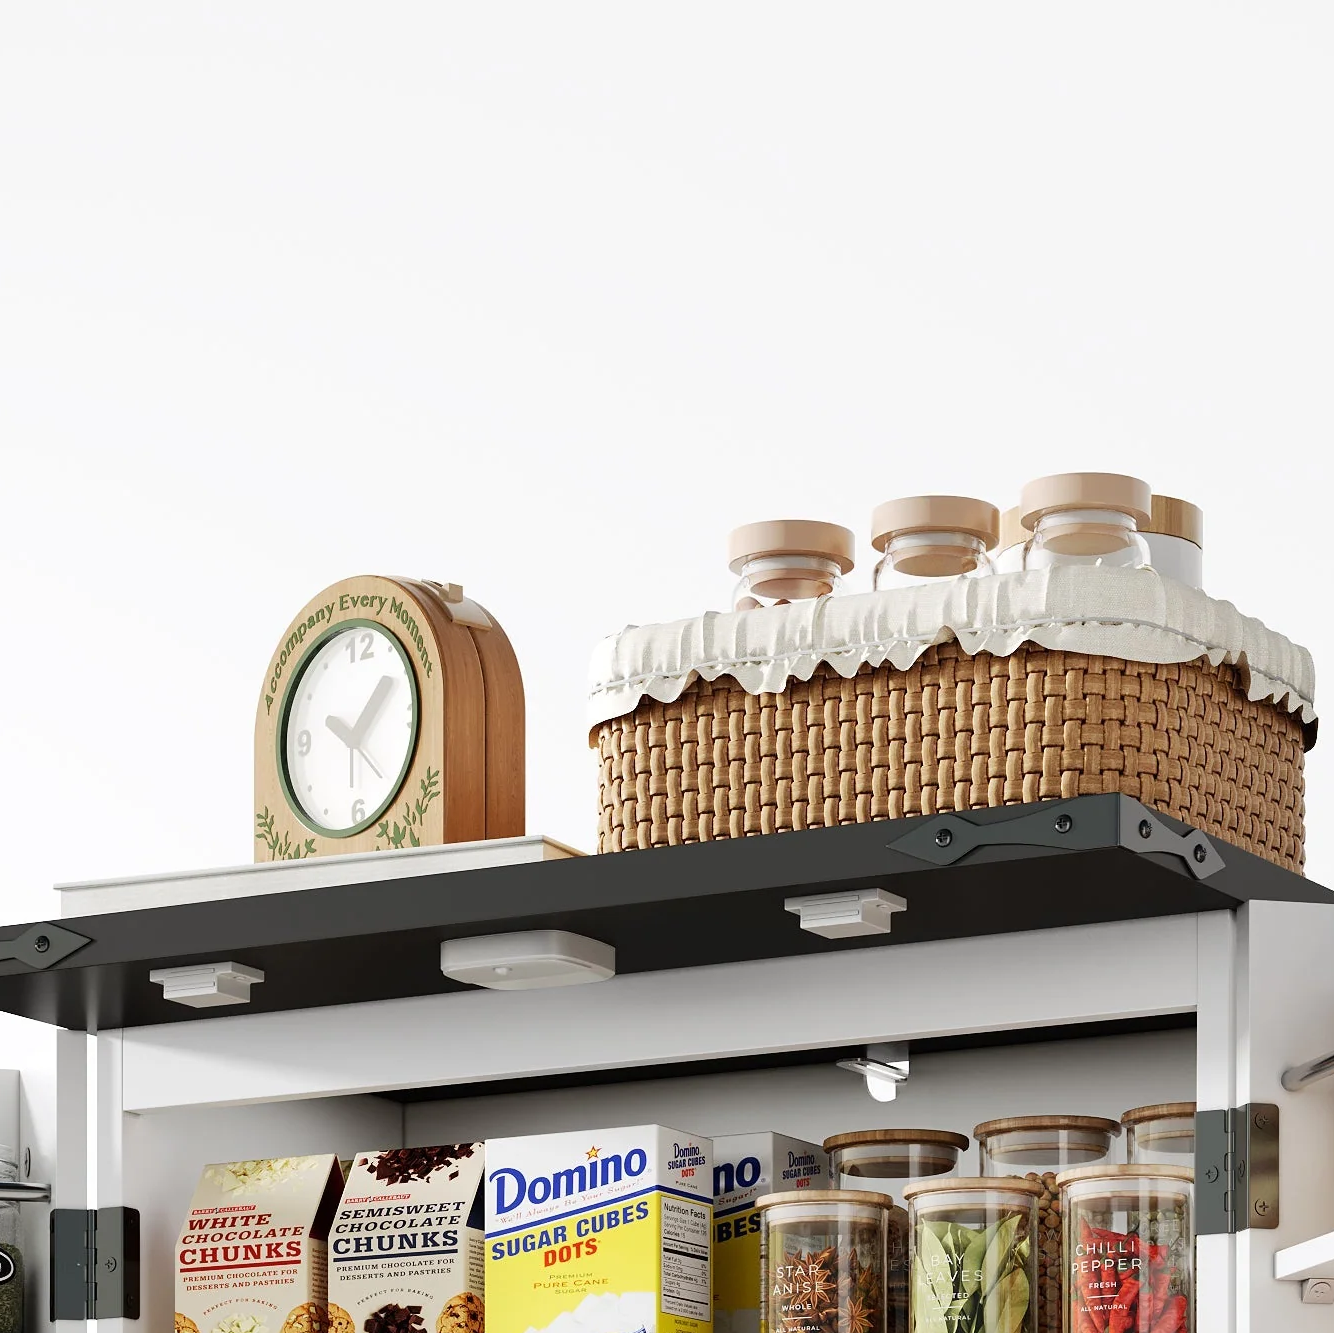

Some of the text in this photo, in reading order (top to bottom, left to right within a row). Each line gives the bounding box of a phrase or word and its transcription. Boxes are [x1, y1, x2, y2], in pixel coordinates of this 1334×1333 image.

[265, 593, 433, 715] Accompany Every Moment
[345, 633, 374, 664] 12
[298, 730, 311, 756] 9
[351, 799, 365, 824] 6
[673, 1143, 700, 1159] Domino
[668, 1156, 705, 1170] SUGAR CUBES
[681, 1169, 694, 1177] DOTS
[489, 1148, 647, 1215] Domino
[340, 1202, 465, 1220] SEMISWEET
[664, 1204, 706, 1219] Nutrition Facts
[189, 1214, 271, 1230] WHITE
[335, 1216, 461, 1234] CHOCOLATE
[182, 1226, 304, 1244] CHOCOLATE
[492, 1202, 649, 1260] SUGAR CUBES
[333, 1230, 458, 1254] CHUNKS
[1076, 1241, 1135, 1256] CHILLI
[180, 1241, 301, 1265] CHUNKS
[544, 1238, 598, 1267] DOTS
[932, 1253, 965, 1266] BAY
[337, 1264, 378, 1272] PREMIUM
[381, 1260, 434, 1269] CHOCOLATE
[776, 1265, 819, 1278] STAR
[1072, 1258, 1142, 1274] PEPPER
[227, 1271, 278, 1279] CHOCOLATE
[340, 1273, 384, 1281] DESSERTS
[409, 1268, 451, 1276] PASTRIES
[187, 1283, 229, 1291] DESSERTS
[253, 1278, 295, 1286] PASTRIES
[773, 1282, 823, 1296] ANISE
